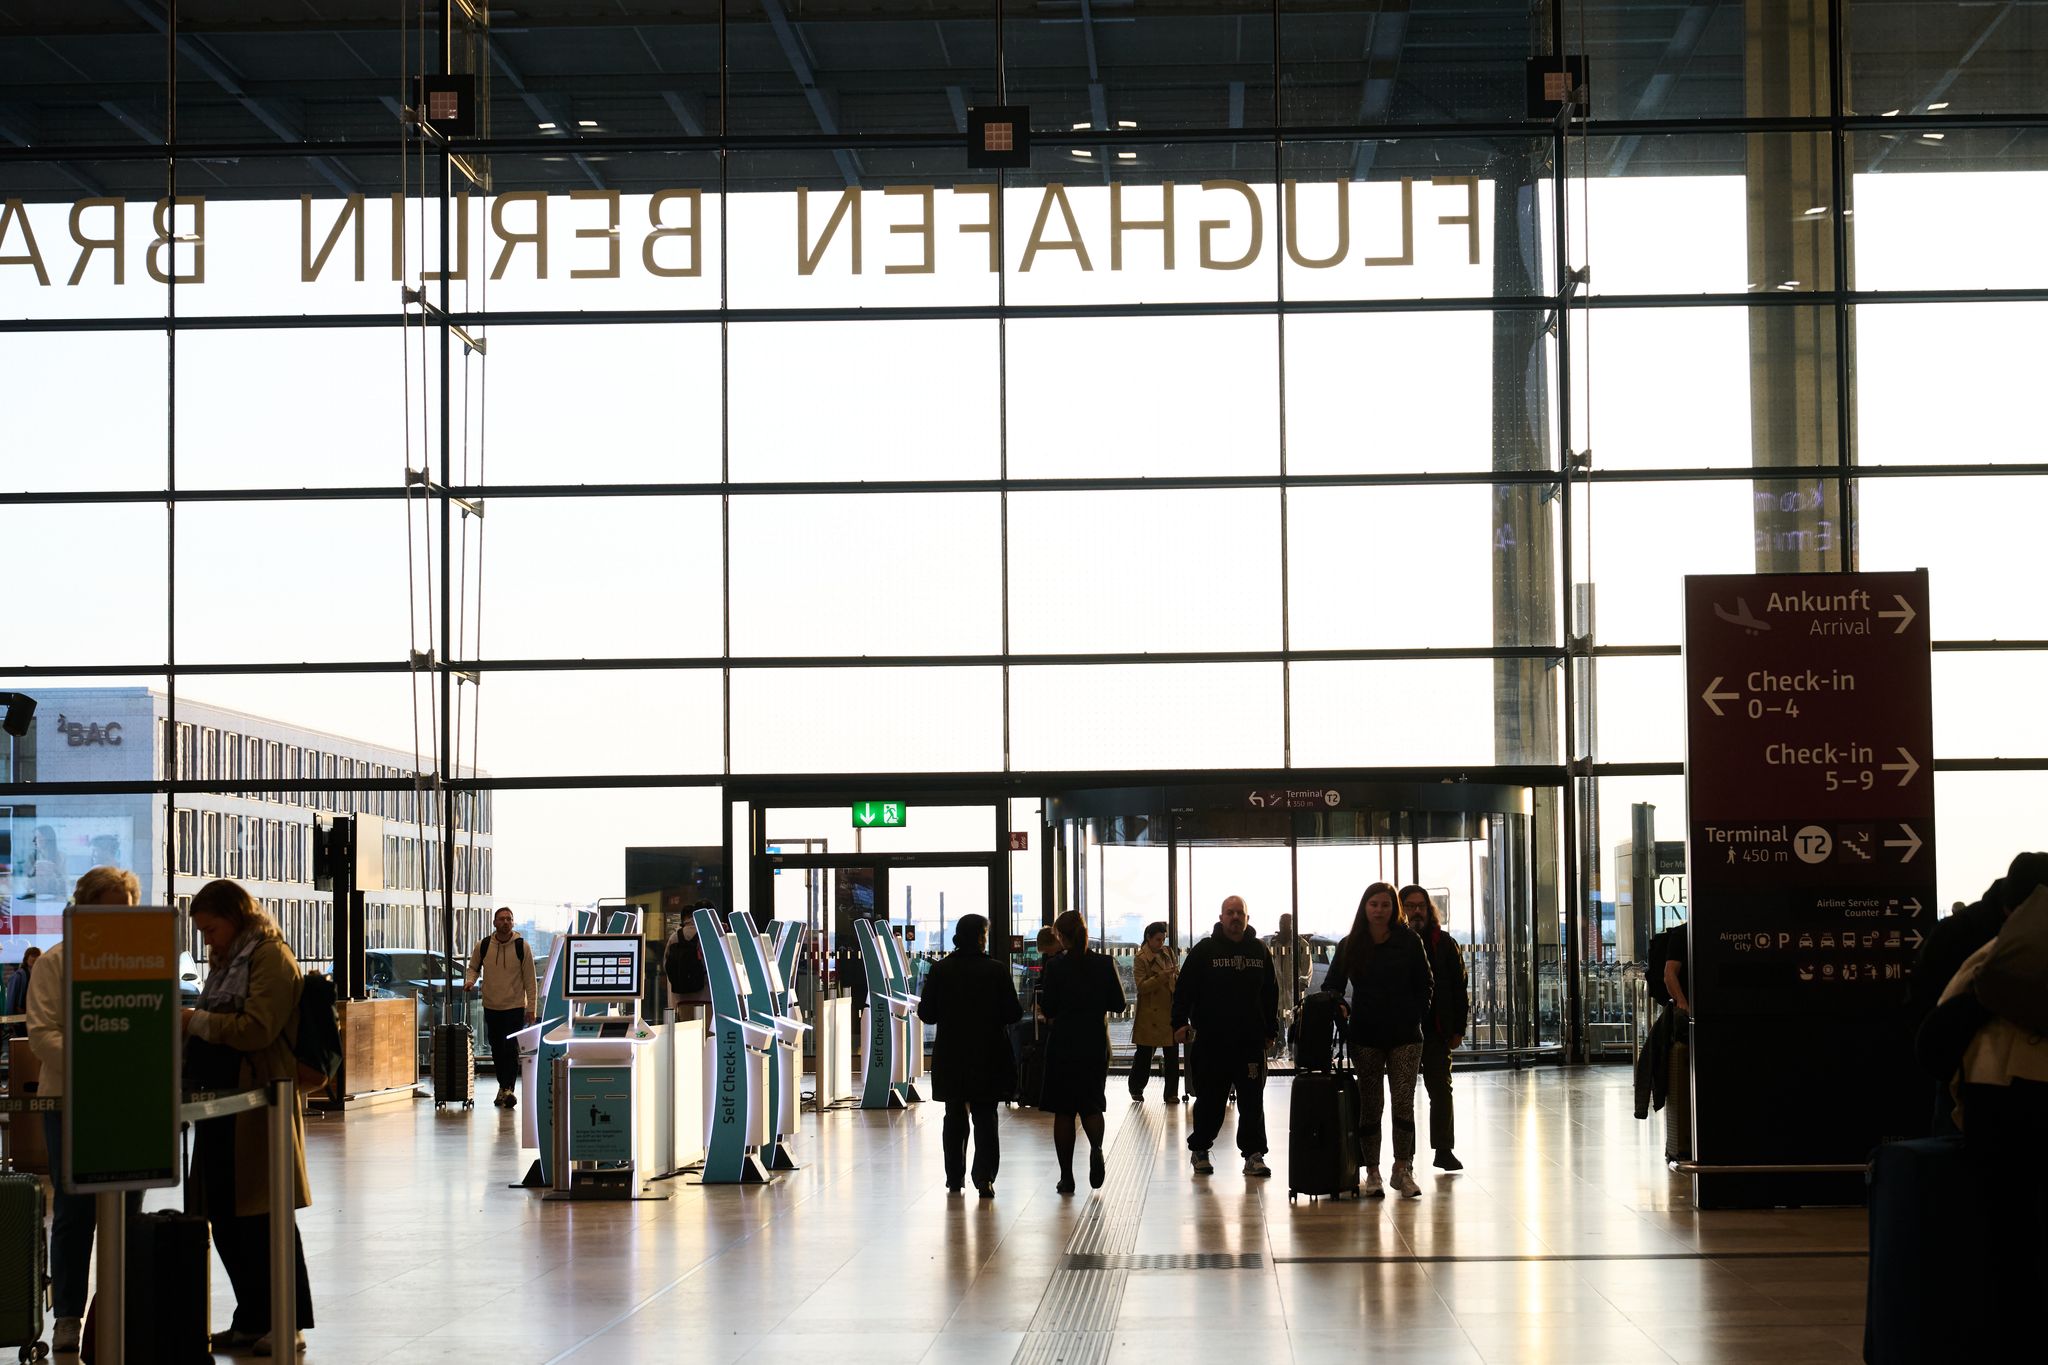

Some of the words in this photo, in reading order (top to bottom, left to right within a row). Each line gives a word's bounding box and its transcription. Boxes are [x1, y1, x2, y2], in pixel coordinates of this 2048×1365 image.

[1767, 589, 1871, 612] Ankunft
[1810, 618, 1871, 636] Arrival
[1747, 669, 1856, 692] Check-in
[1766, 742, 1874, 765] Check-in
[1286, 789, 1323, 798] Terminal
[1327, 794, 1338, 803] T2
[1705, 825, 1789, 843] Terminal
[1798, 835, 1827, 855] T2
[1743, 848, 1770, 862] 450
[1775, 850, 1789, 862] m
[1817, 898, 1846, 908] Airline
[1848, 898, 1880, 908] Service
[1844, 908, 1880, 918] Counter
[1720, 932, 1752, 942] Airport
[1734, 942, 1752, 952] City
[79, 952, 166, 970] Lufthansa
[80, 990, 164, 1011] Economy
[80, 1013, 130, 1032] Class
[875, 1003, 885, 1046] Check-in
[723, 1031, 736, 1092] Check-in
[875, 1048, 884, 1068] Self
[29, 1098, 56, 1111] BER
[722, 1096, 735, 1124] Self
